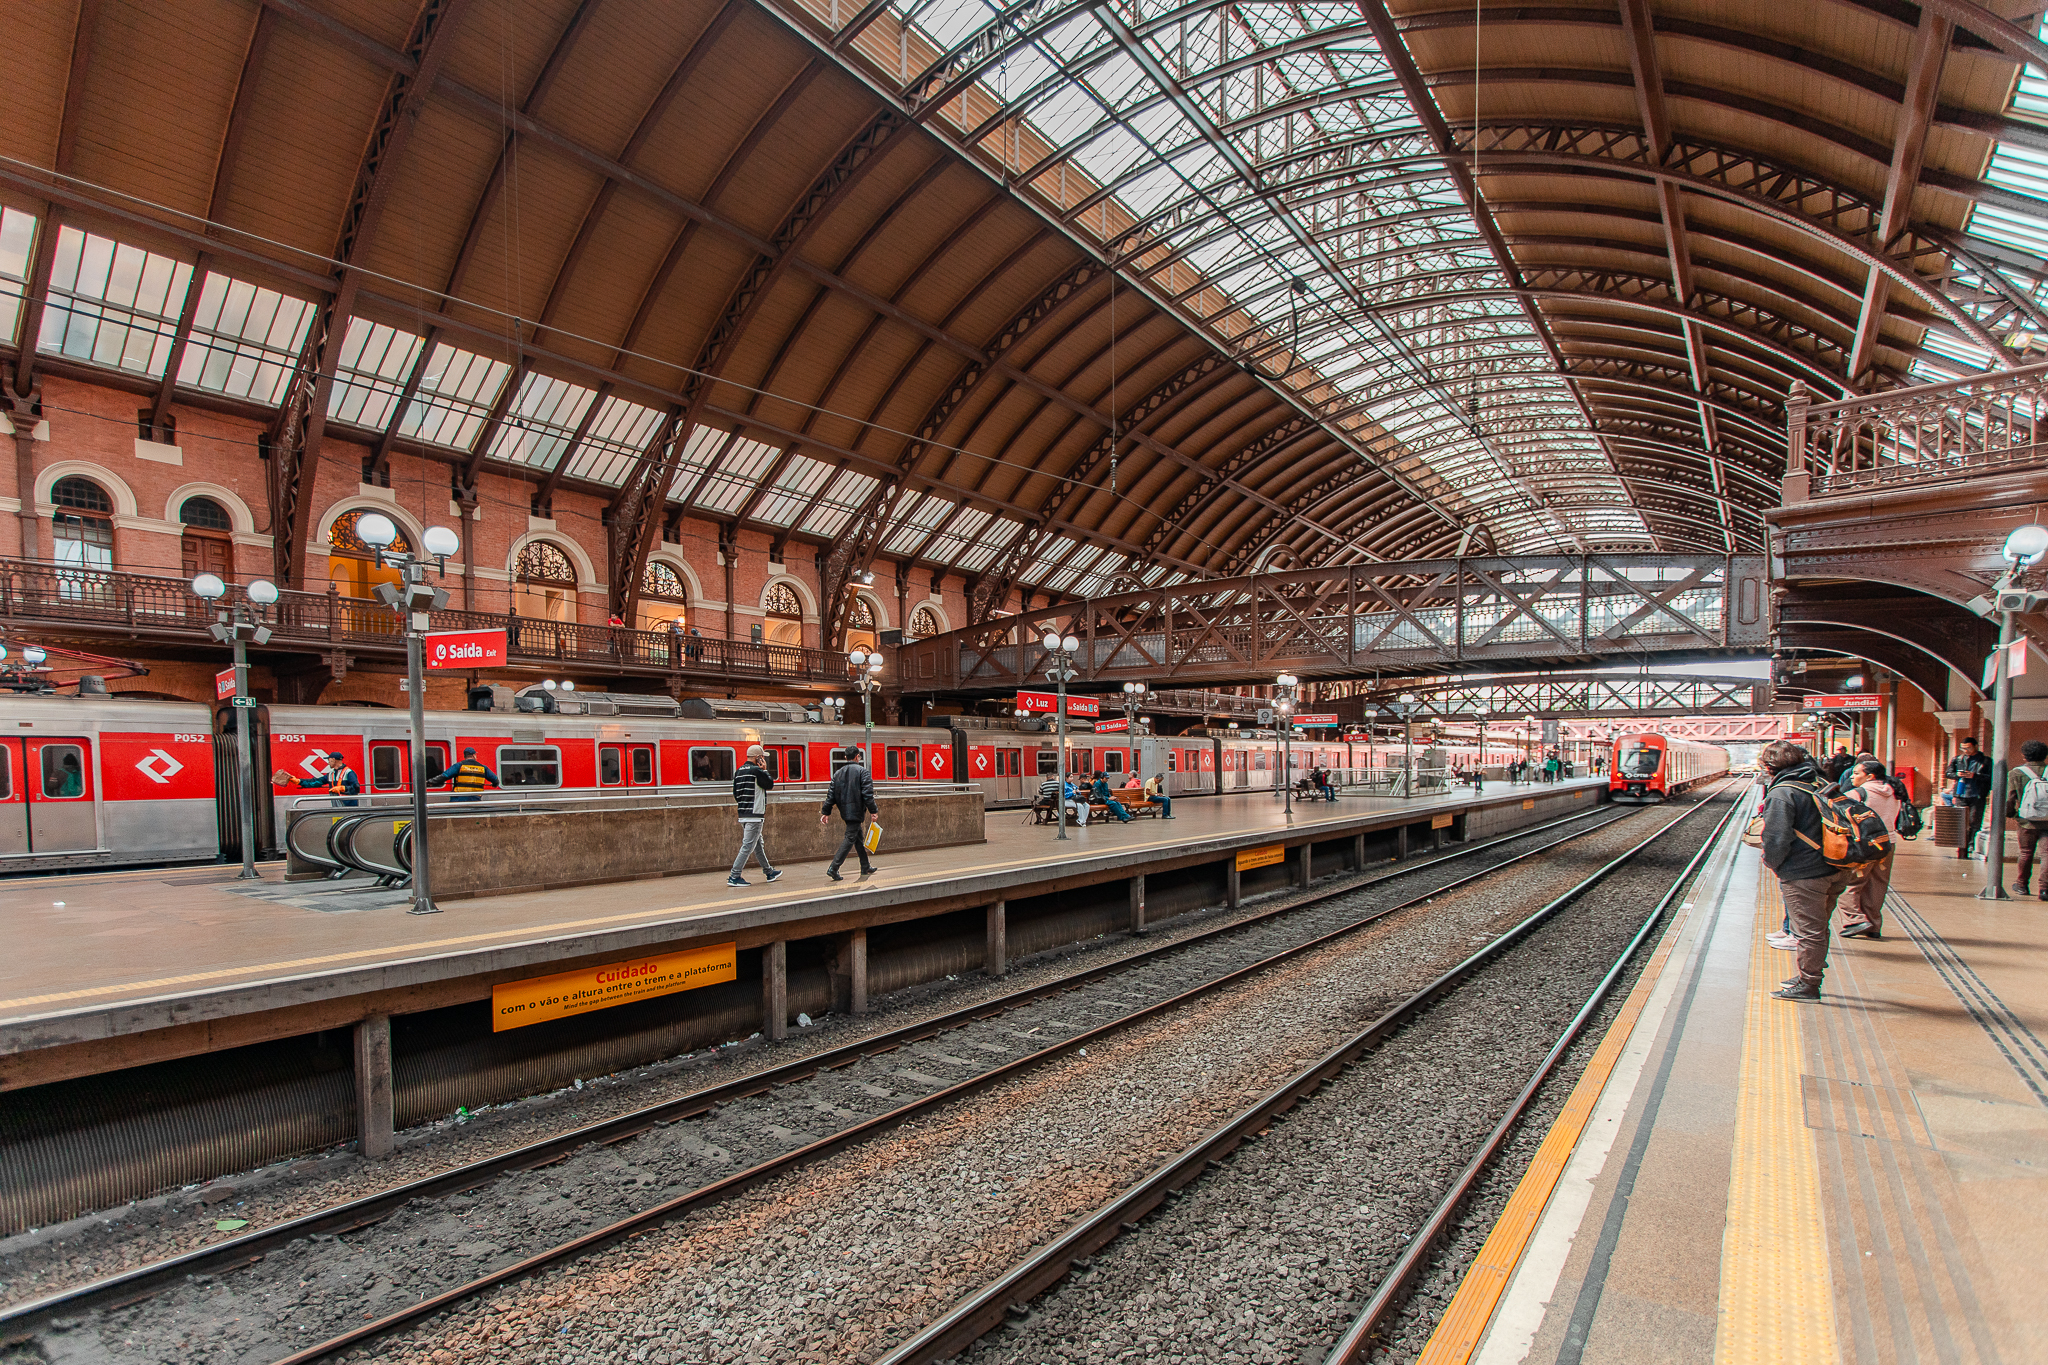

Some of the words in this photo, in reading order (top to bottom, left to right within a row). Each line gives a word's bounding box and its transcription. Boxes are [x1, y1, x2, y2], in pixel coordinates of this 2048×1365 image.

[449, 642, 483, 659] Saída
[486, 649, 497, 657] Exit
[1036, 698, 1049, 708] Luz
[174, 733, 206, 743] P052
[279, 734, 306, 743] P051
[596, 962, 658, 984] Cuidado
[501, 1003, 526, 1015] com
[529, 1001, 536, 1009] o
[539, 996, 560, 1007] vão
[562, 994, 569, 1003] e
[572, 986, 604, 1001] altura
[606, 981, 633, 993] entre
[635, 979, 642, 987] o
[644, 975, 667, 986] trem
[676, 971, 682, 979] a
[684, 962, 732, 978] plataforma
[563, 1002, 578, 1010] Mind
[579, 1000, 588, 1008] the
[589, 998, 599, 1006] gap
[600, 993, 623, 1002] between
[633, 988, 646, 996] train
[656, 984, 665, 992] the
[665, 980, 687, 989] platform
